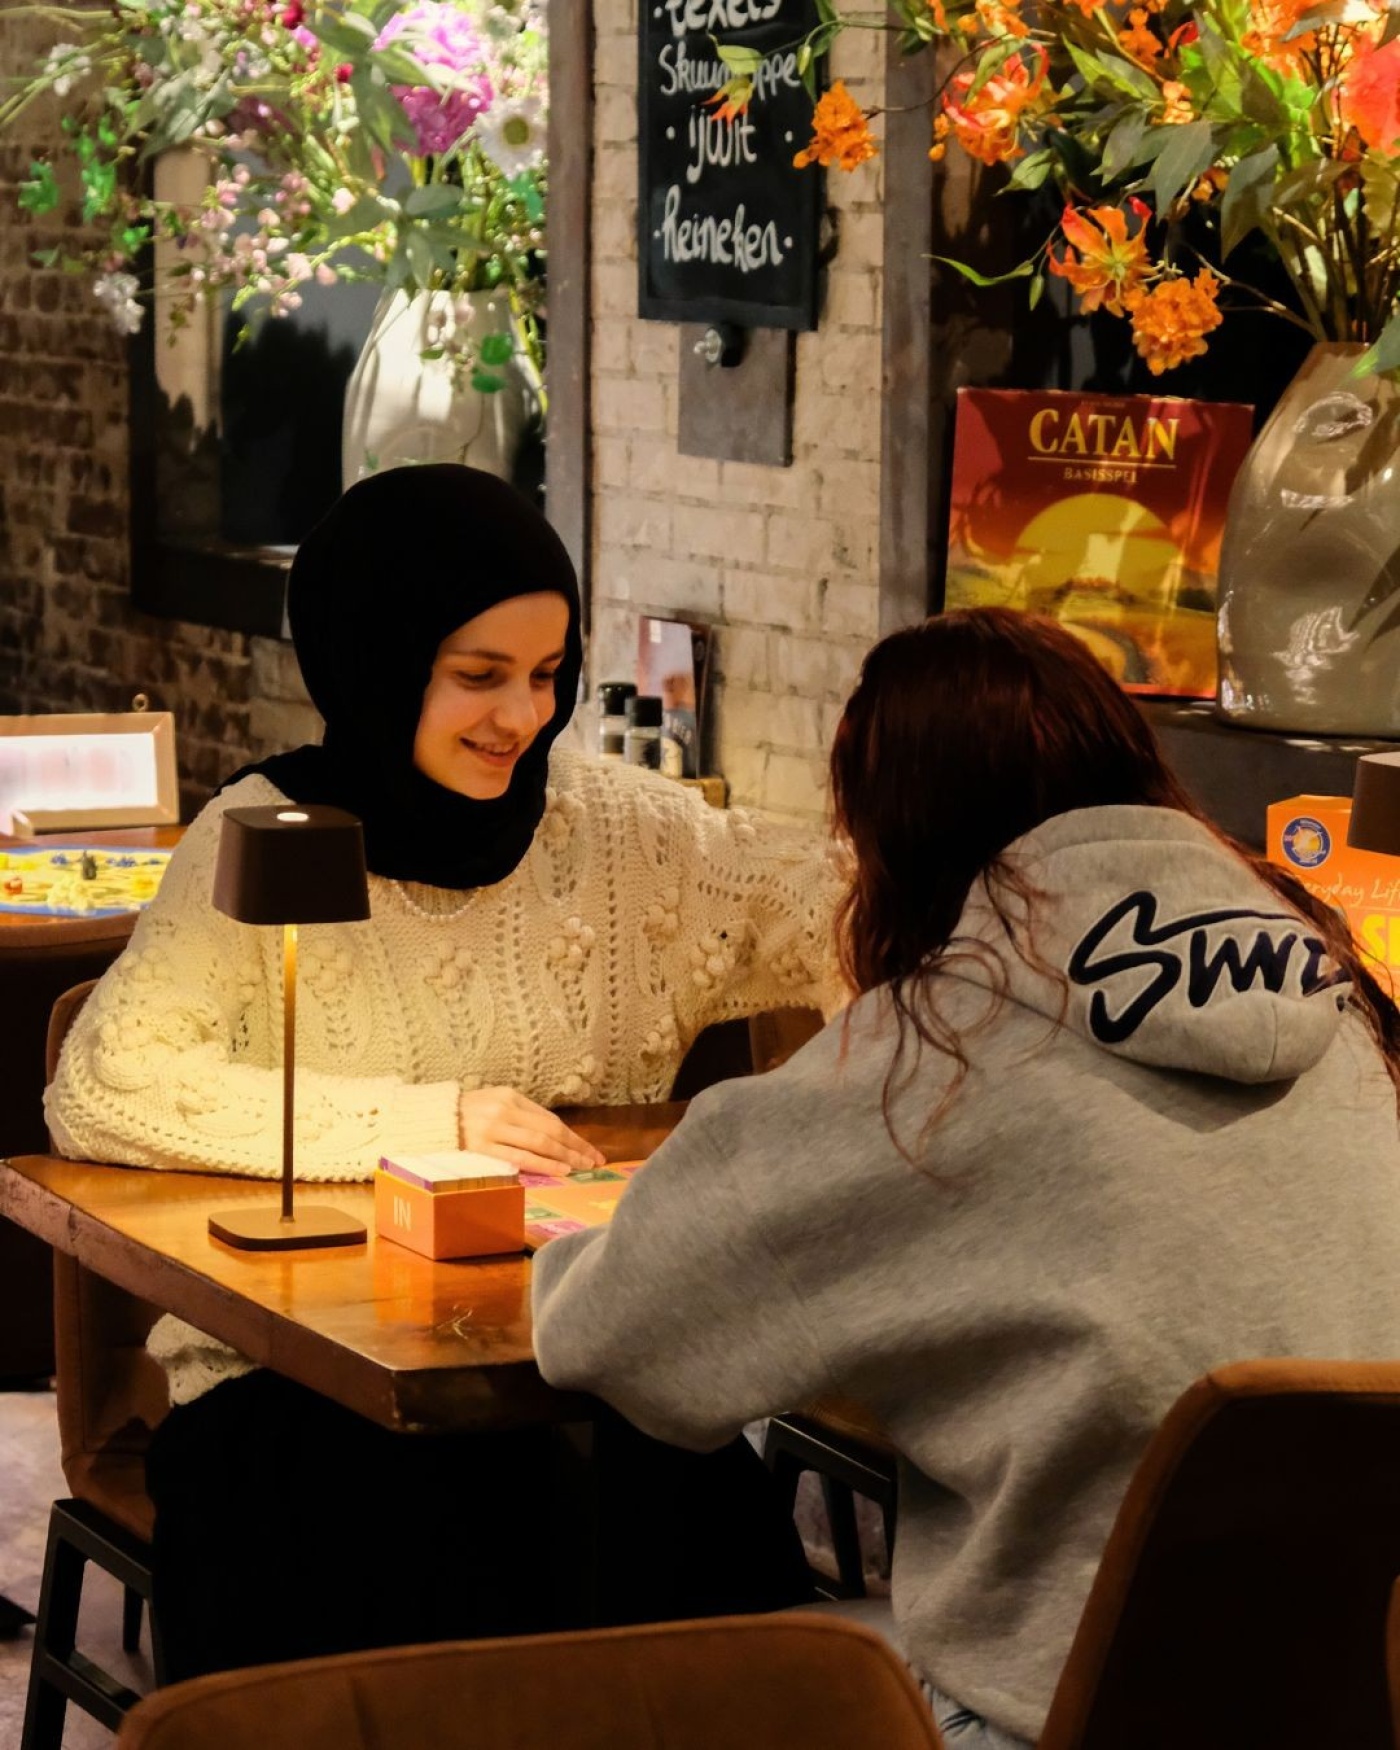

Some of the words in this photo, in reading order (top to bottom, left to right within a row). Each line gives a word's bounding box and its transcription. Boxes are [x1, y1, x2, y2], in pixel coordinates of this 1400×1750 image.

[662, 184, 784, 274] heineken
[1029, 408, 1180, 461] CATAN
[1304, 873, 1364, 909] eryday
[1371, 878, 1400, 907] Lif
[393, 1195, 411, 1232] IN
